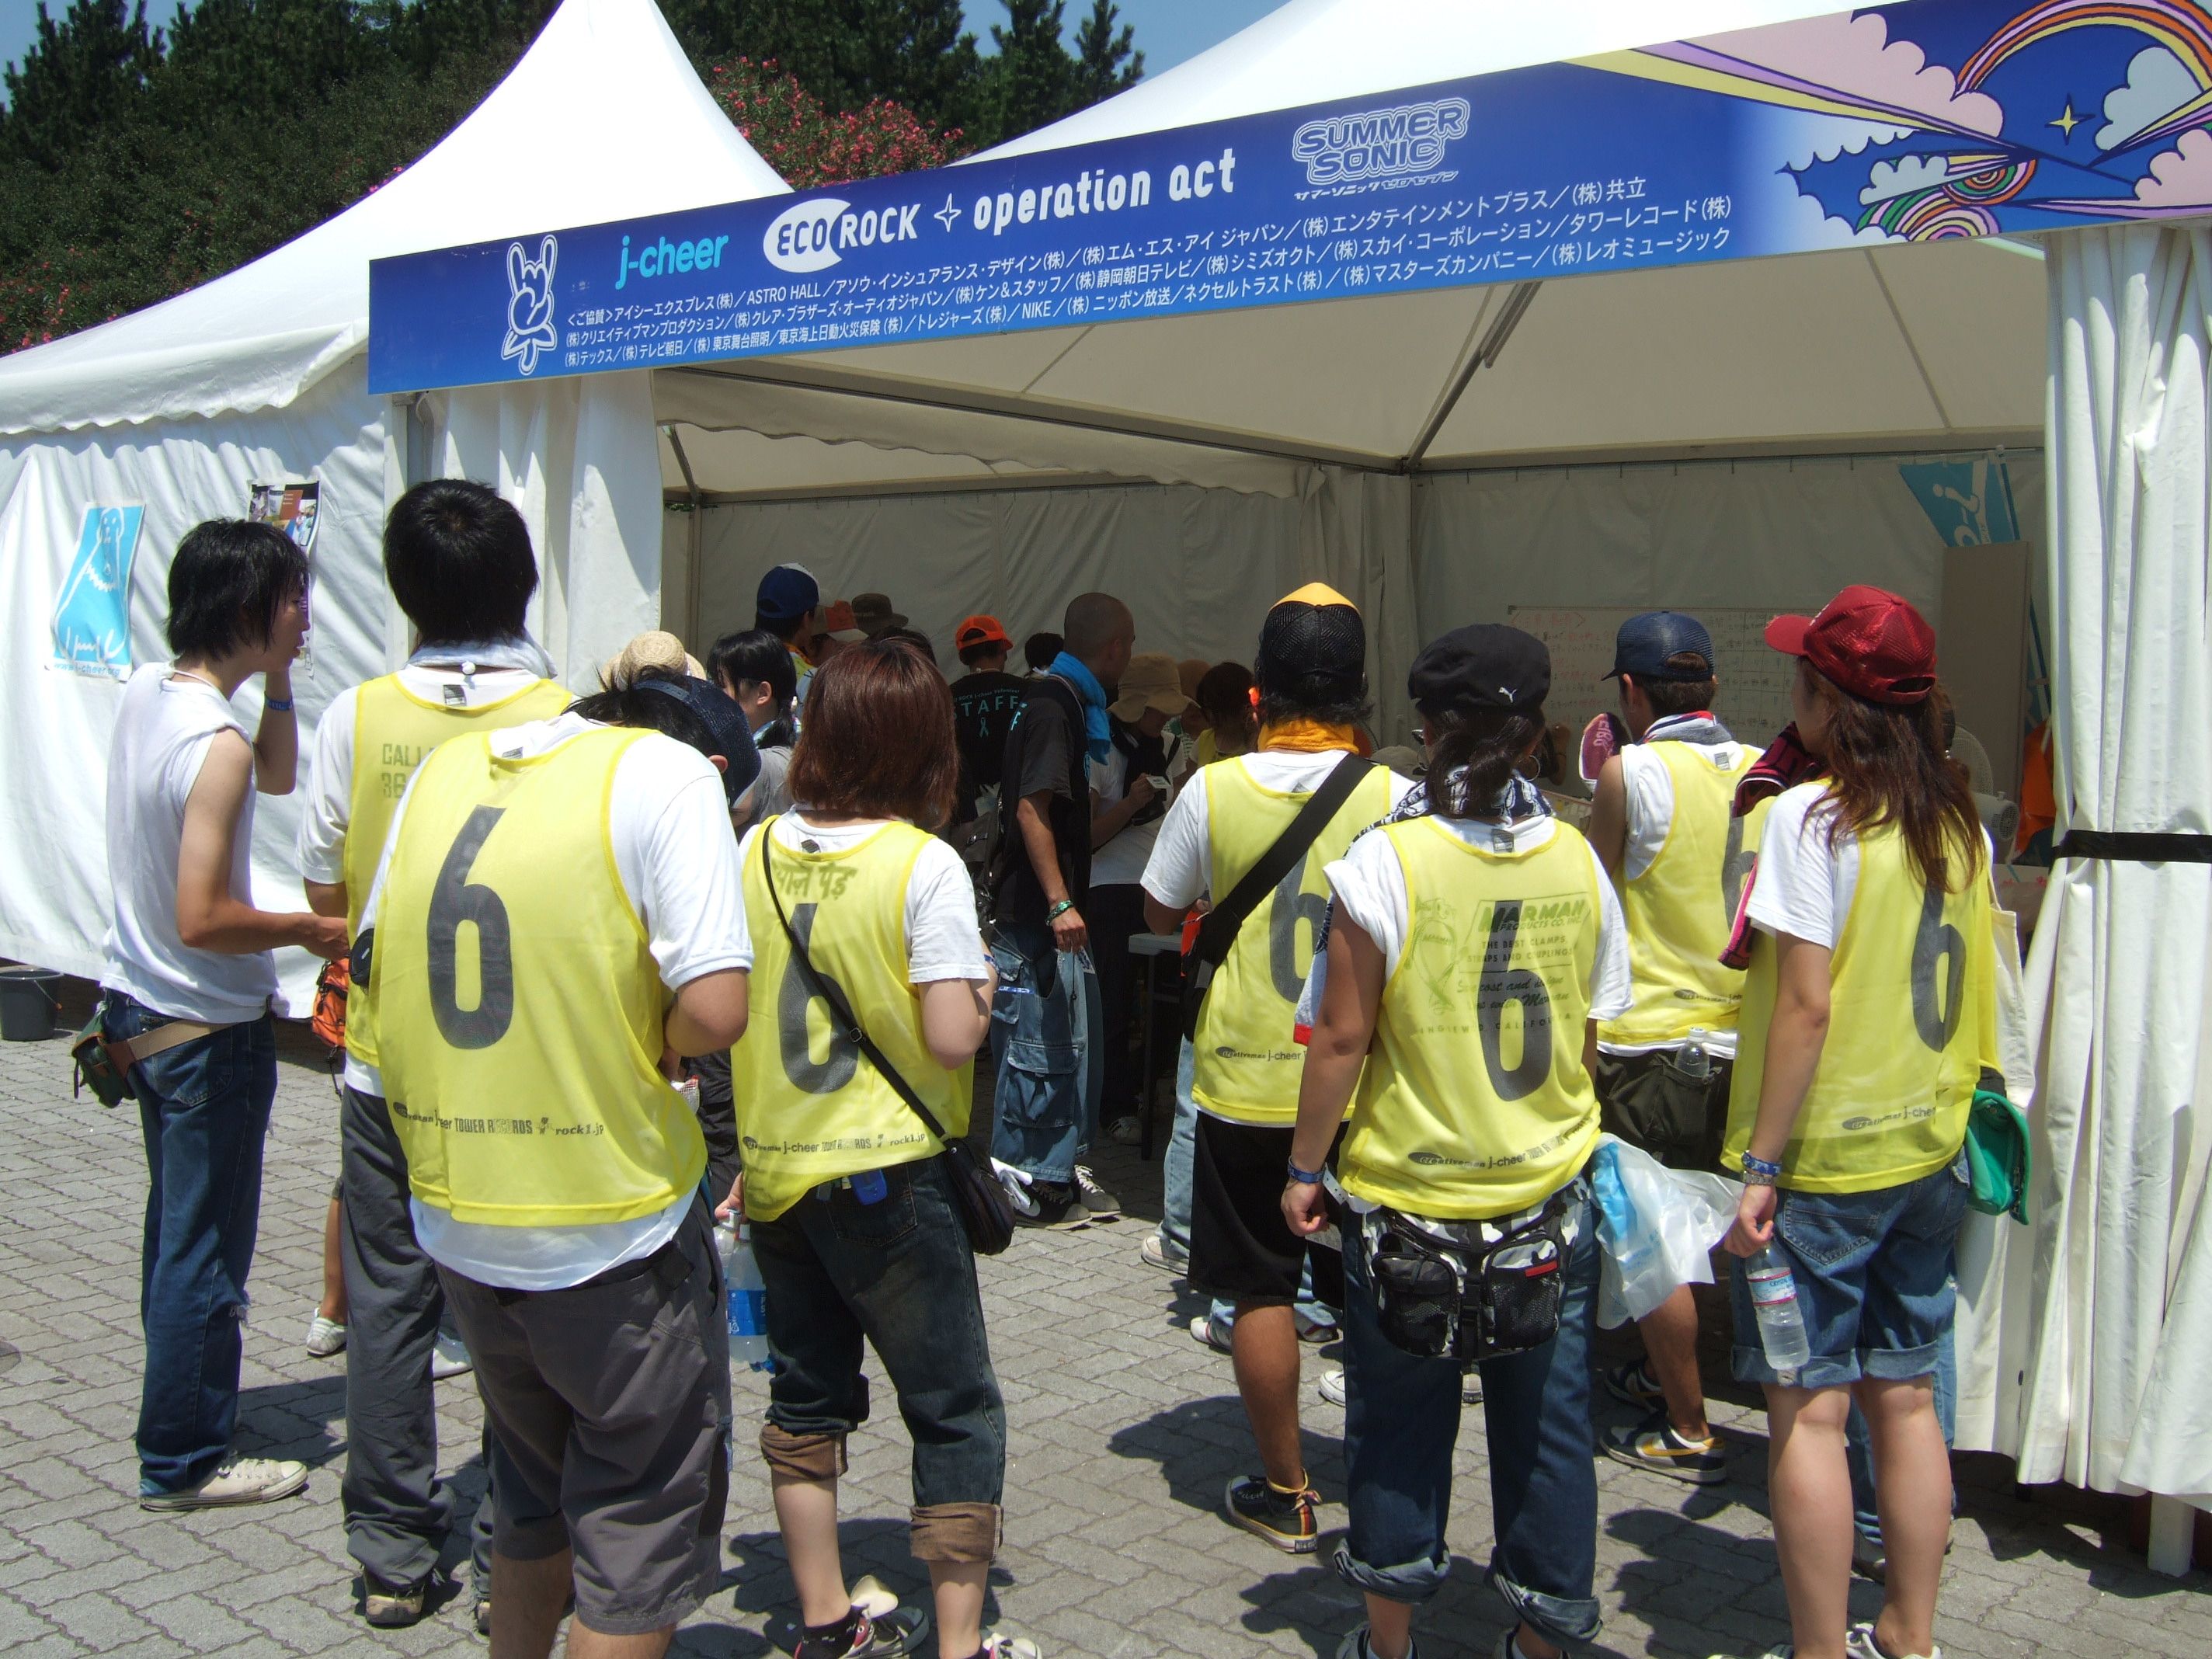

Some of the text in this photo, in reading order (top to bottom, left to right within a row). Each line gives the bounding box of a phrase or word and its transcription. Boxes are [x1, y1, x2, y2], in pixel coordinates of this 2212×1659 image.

[1296, 103, 1466, 155] SUMMER
[1313, 138, 1440, 178] SONIC
[777, 149, 1236, 257] ECO ROCK operation act
[615, 234, 729, 290] j-cheer
[955, 695, 1019, 718] TAFF
[426, 804, 514, 1050] 6
[1270, 850, 1329, 1003] 6
[1502, 939, 1525, 949] BEST
[1911, 857, 1967, 1053] 6
[778, 903, 861, 1094] 6
[1476, 900, 1553, 1101] 6
[455, 1118, 485, 1133] TOWER
[783, 1140, 820, 1155] j-cheer
[1488, 1153, 1526, 1169] j-cheer
